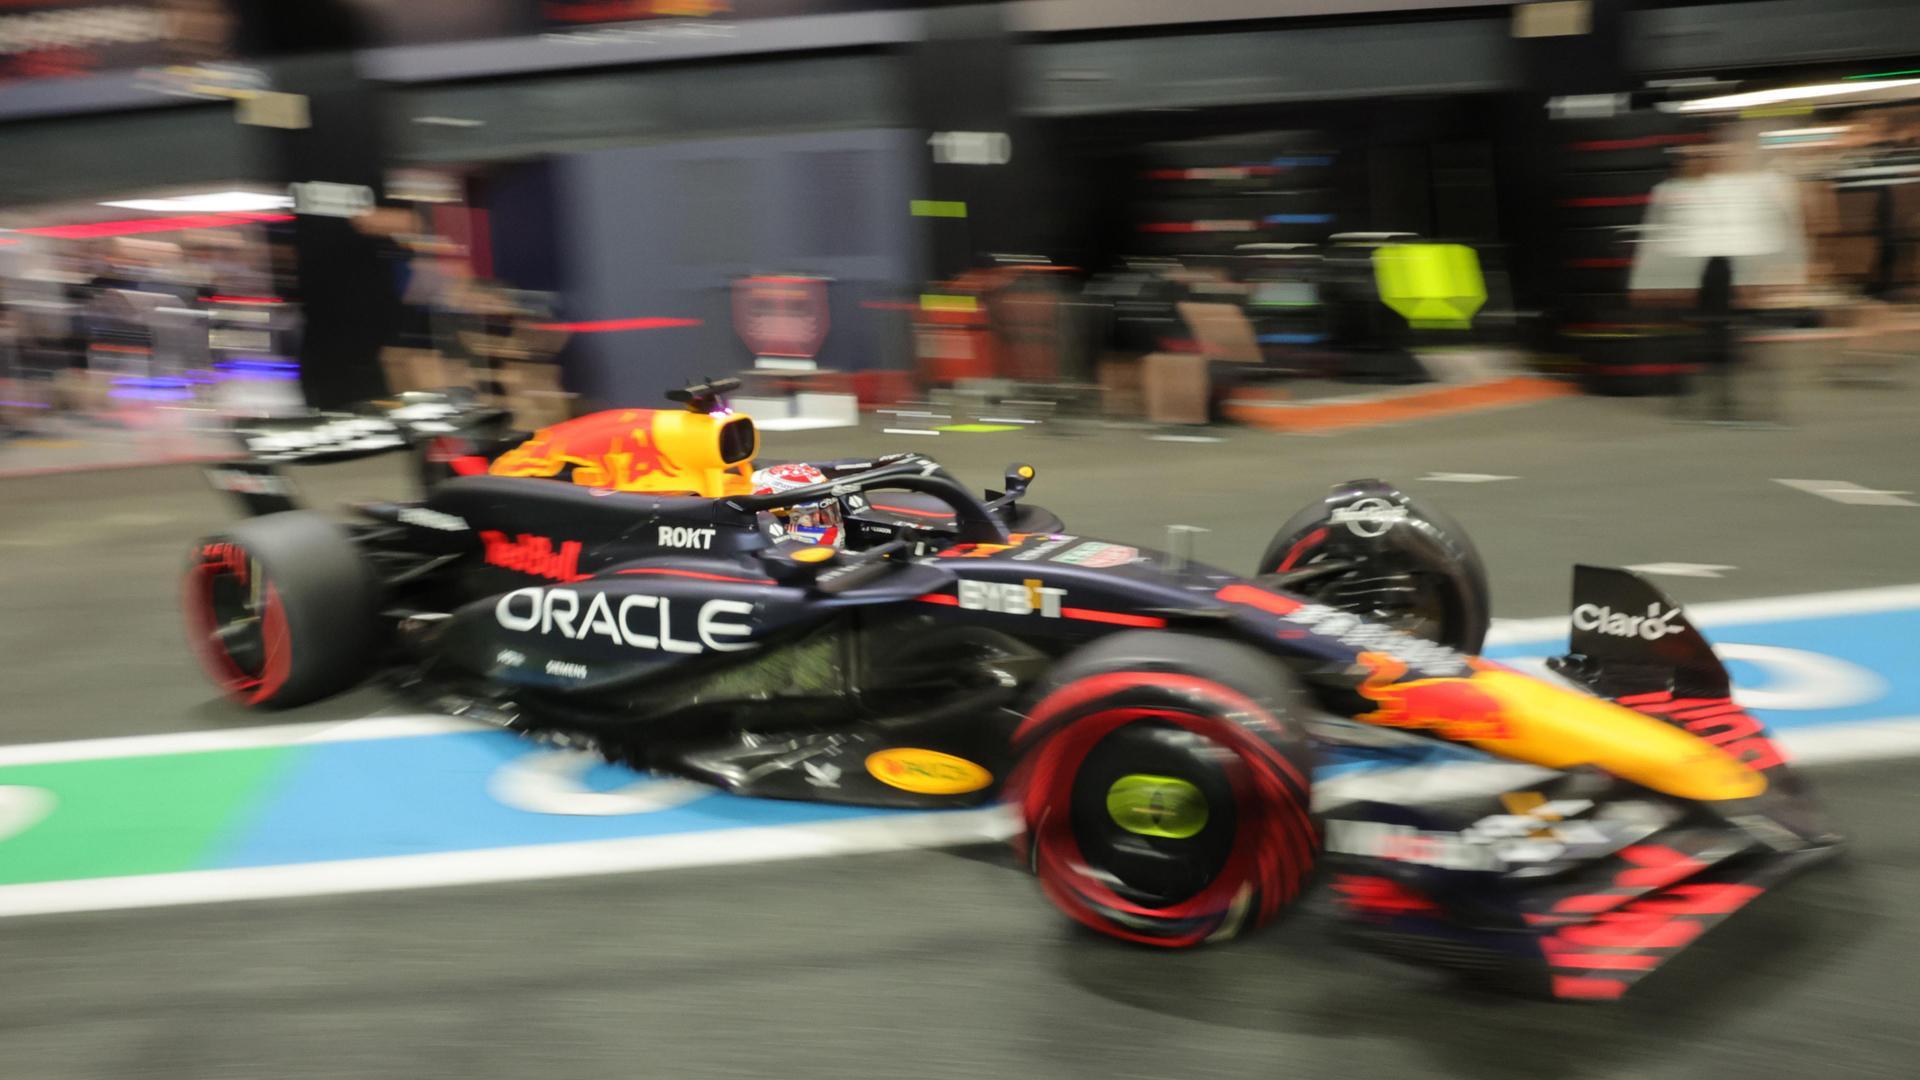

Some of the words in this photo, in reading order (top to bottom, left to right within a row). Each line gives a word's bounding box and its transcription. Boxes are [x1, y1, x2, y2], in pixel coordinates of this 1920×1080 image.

[658, 526, 716, 550] ROKT
[496, 587, 760, 654] ORACLE
[1573, 602, 1669, 640] Claro
